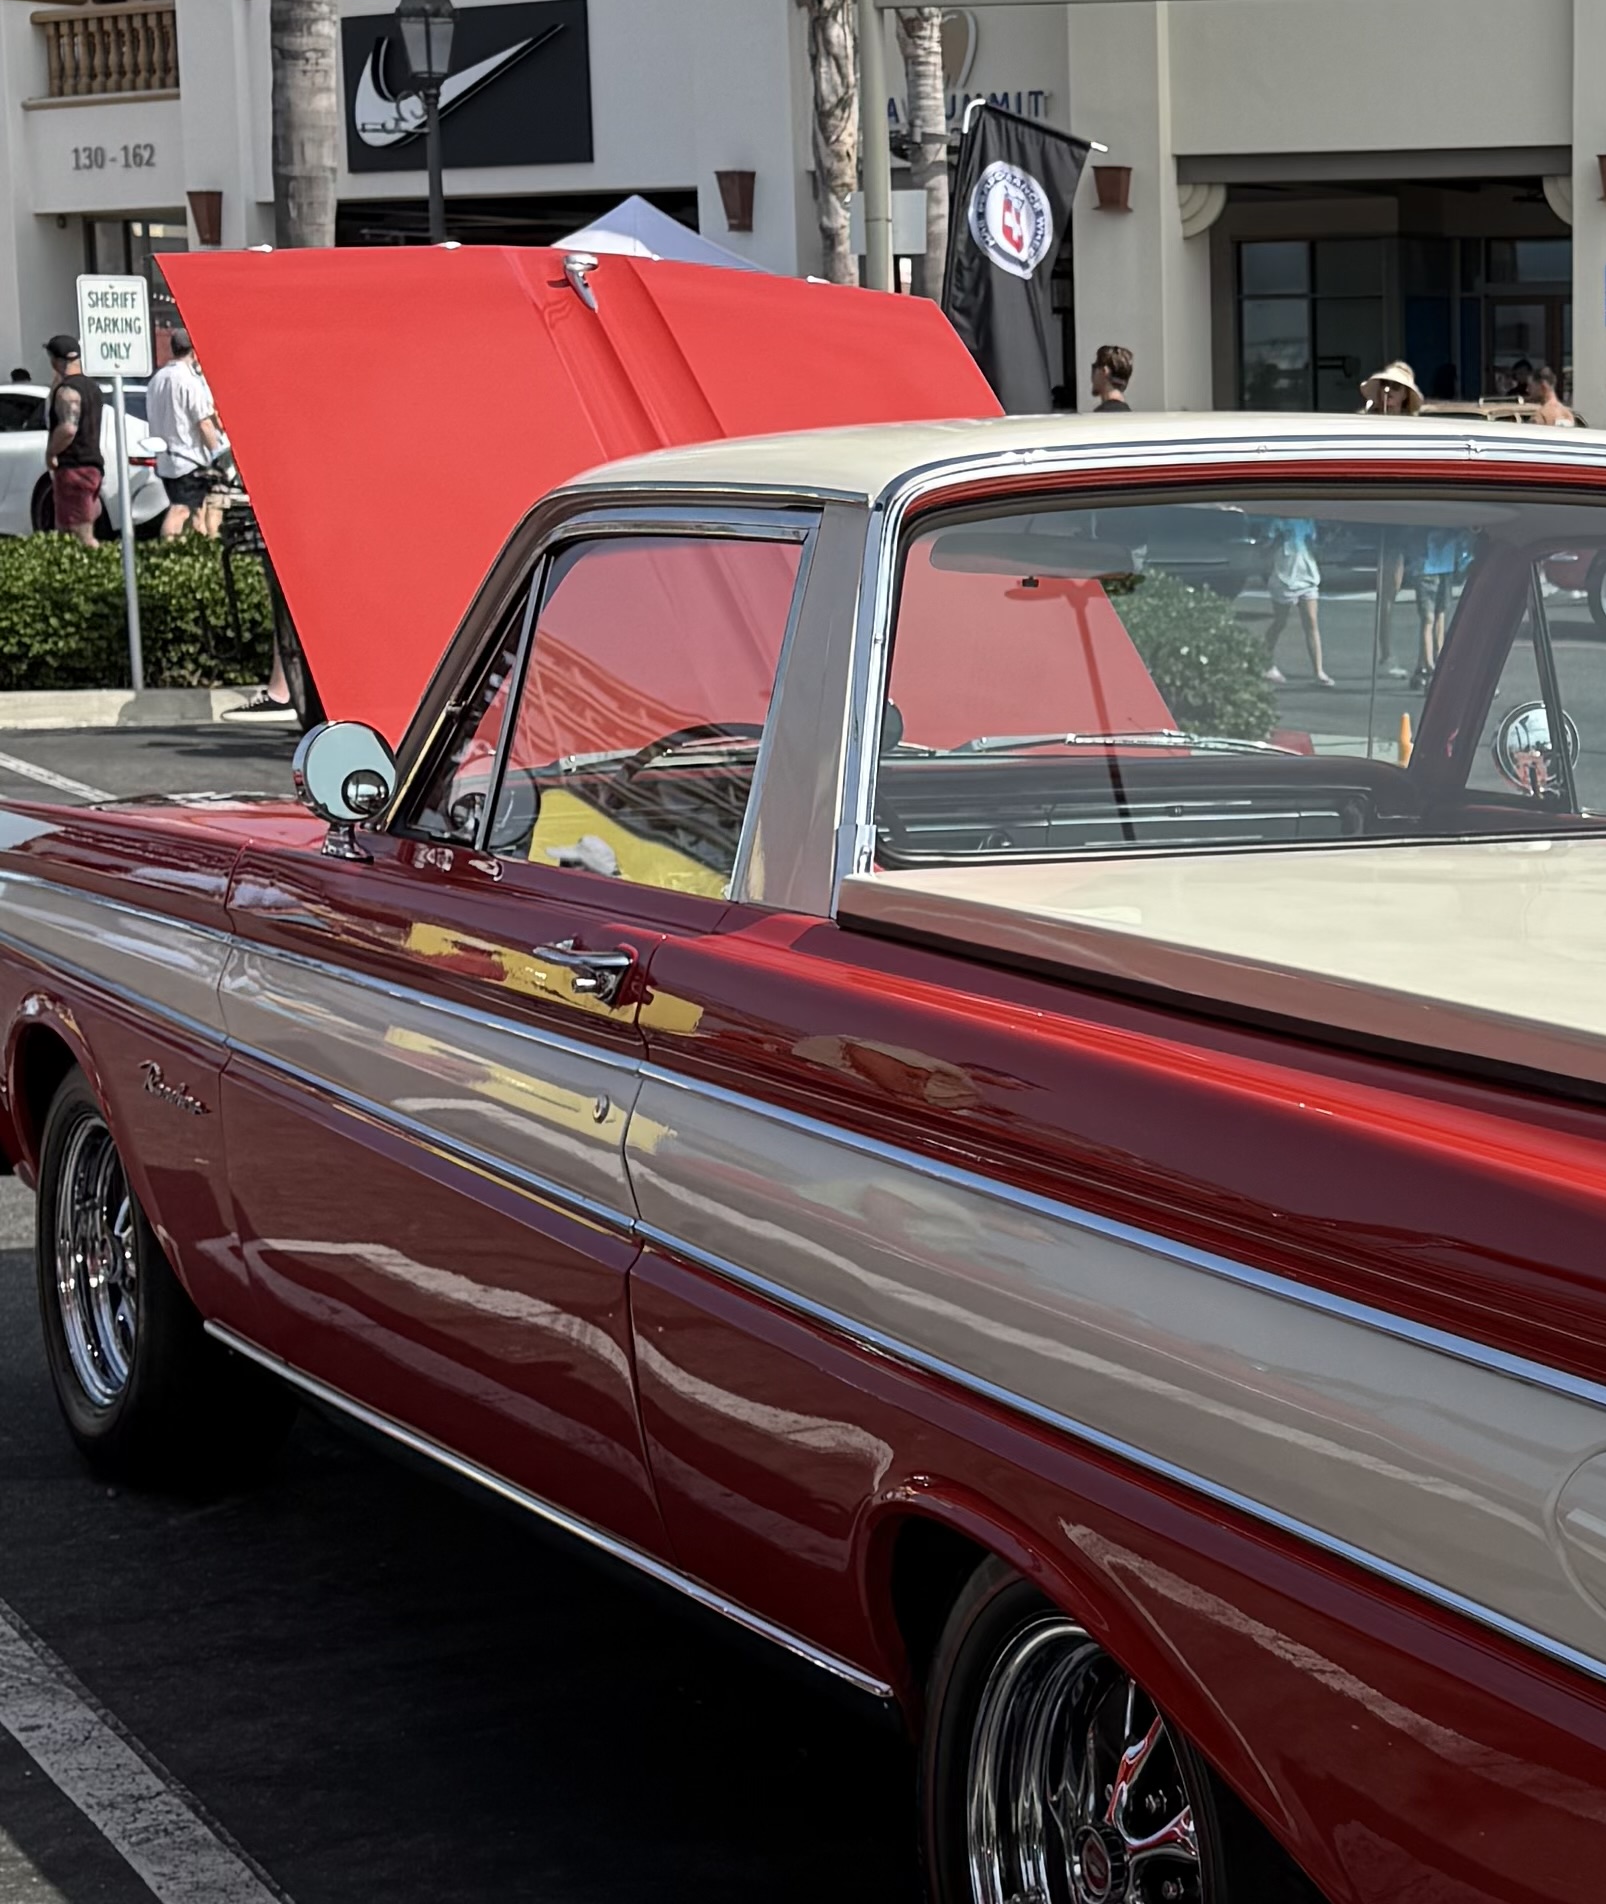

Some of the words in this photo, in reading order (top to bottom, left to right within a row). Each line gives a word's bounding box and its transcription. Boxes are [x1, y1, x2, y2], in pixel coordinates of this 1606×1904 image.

[945, 90, 1045, 121] UMIT
[87, 290, 137, 309] SHERIFF
[87, 316, 142, 335] PARKING
[100, 341, 132, 361] ONLY
